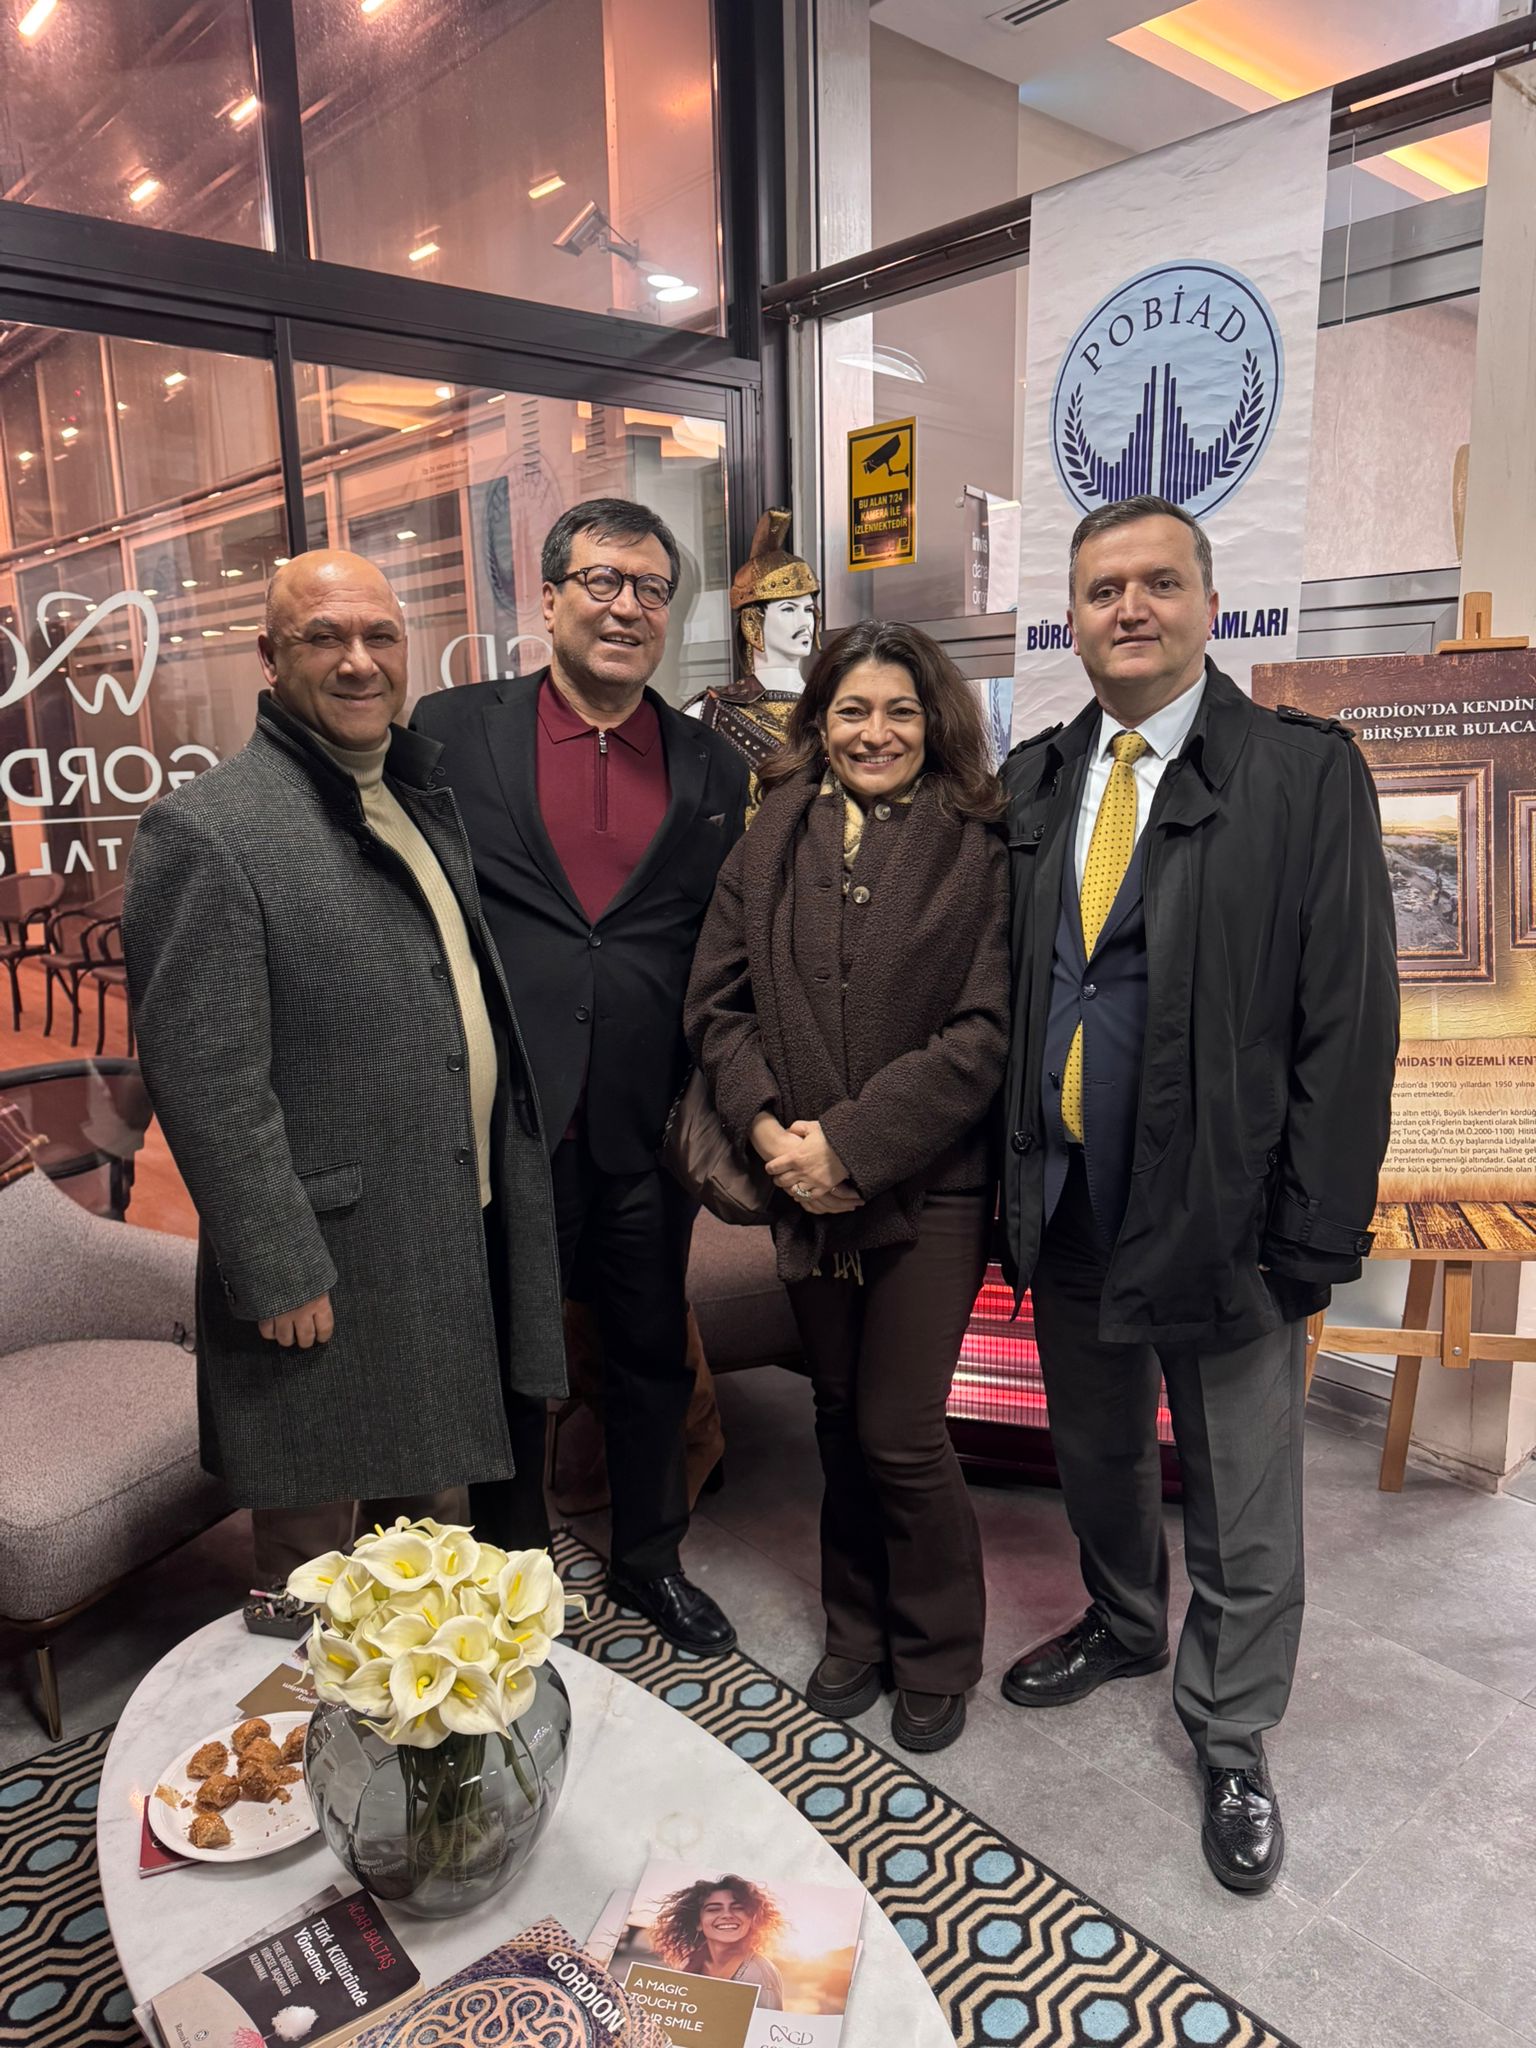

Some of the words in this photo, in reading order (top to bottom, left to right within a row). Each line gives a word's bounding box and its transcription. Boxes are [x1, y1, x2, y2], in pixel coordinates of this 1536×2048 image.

[1080, 284, 1247, 375] POBİAD
[858, 499, 869, 510] BU
[870, 496, 888, 507] ALAN
[860, 507, 889, 522] KAMERA
[1027, 619, 1073, 651] BÜRO
[1211, 607, 1289, 640] AMLARI
[1340, 702, 1459, 720] GORDİON'DA
[1462, 695, 1536, 714] KENDİN
[1362, 724, 1458, 742] BİRŞEYLER
[1462, 720, 1536, 736] BULACA
[1456, 1054, 1505, 1066] GİZEMLİ
[1393, 1081, 1428, 1089] ordion'da
[1495, 1080, 1513, 1088] 1950
[1510, 1109, 1536, 1118] kördüğ
[346, 1902, 372, 1931] ACAR
[363, 1928, 396, 1971] BALTAŞ
[293, 1926, 333, 1985] Yönetmek
[312, 1917, 335, 1948] Türk
[325, 1944, 369, 2008] Kültüründe
[547, 1952, 627, 2033] GORDION
[633, 1978, 644, 1989] A
[645, 1979, 689, 1997] MAGIC
[630, 1992, 677, 2011] TOUCH
[679, 2002, 698, 2014] TO
[663, 2016, 704, 2032] SMILE
